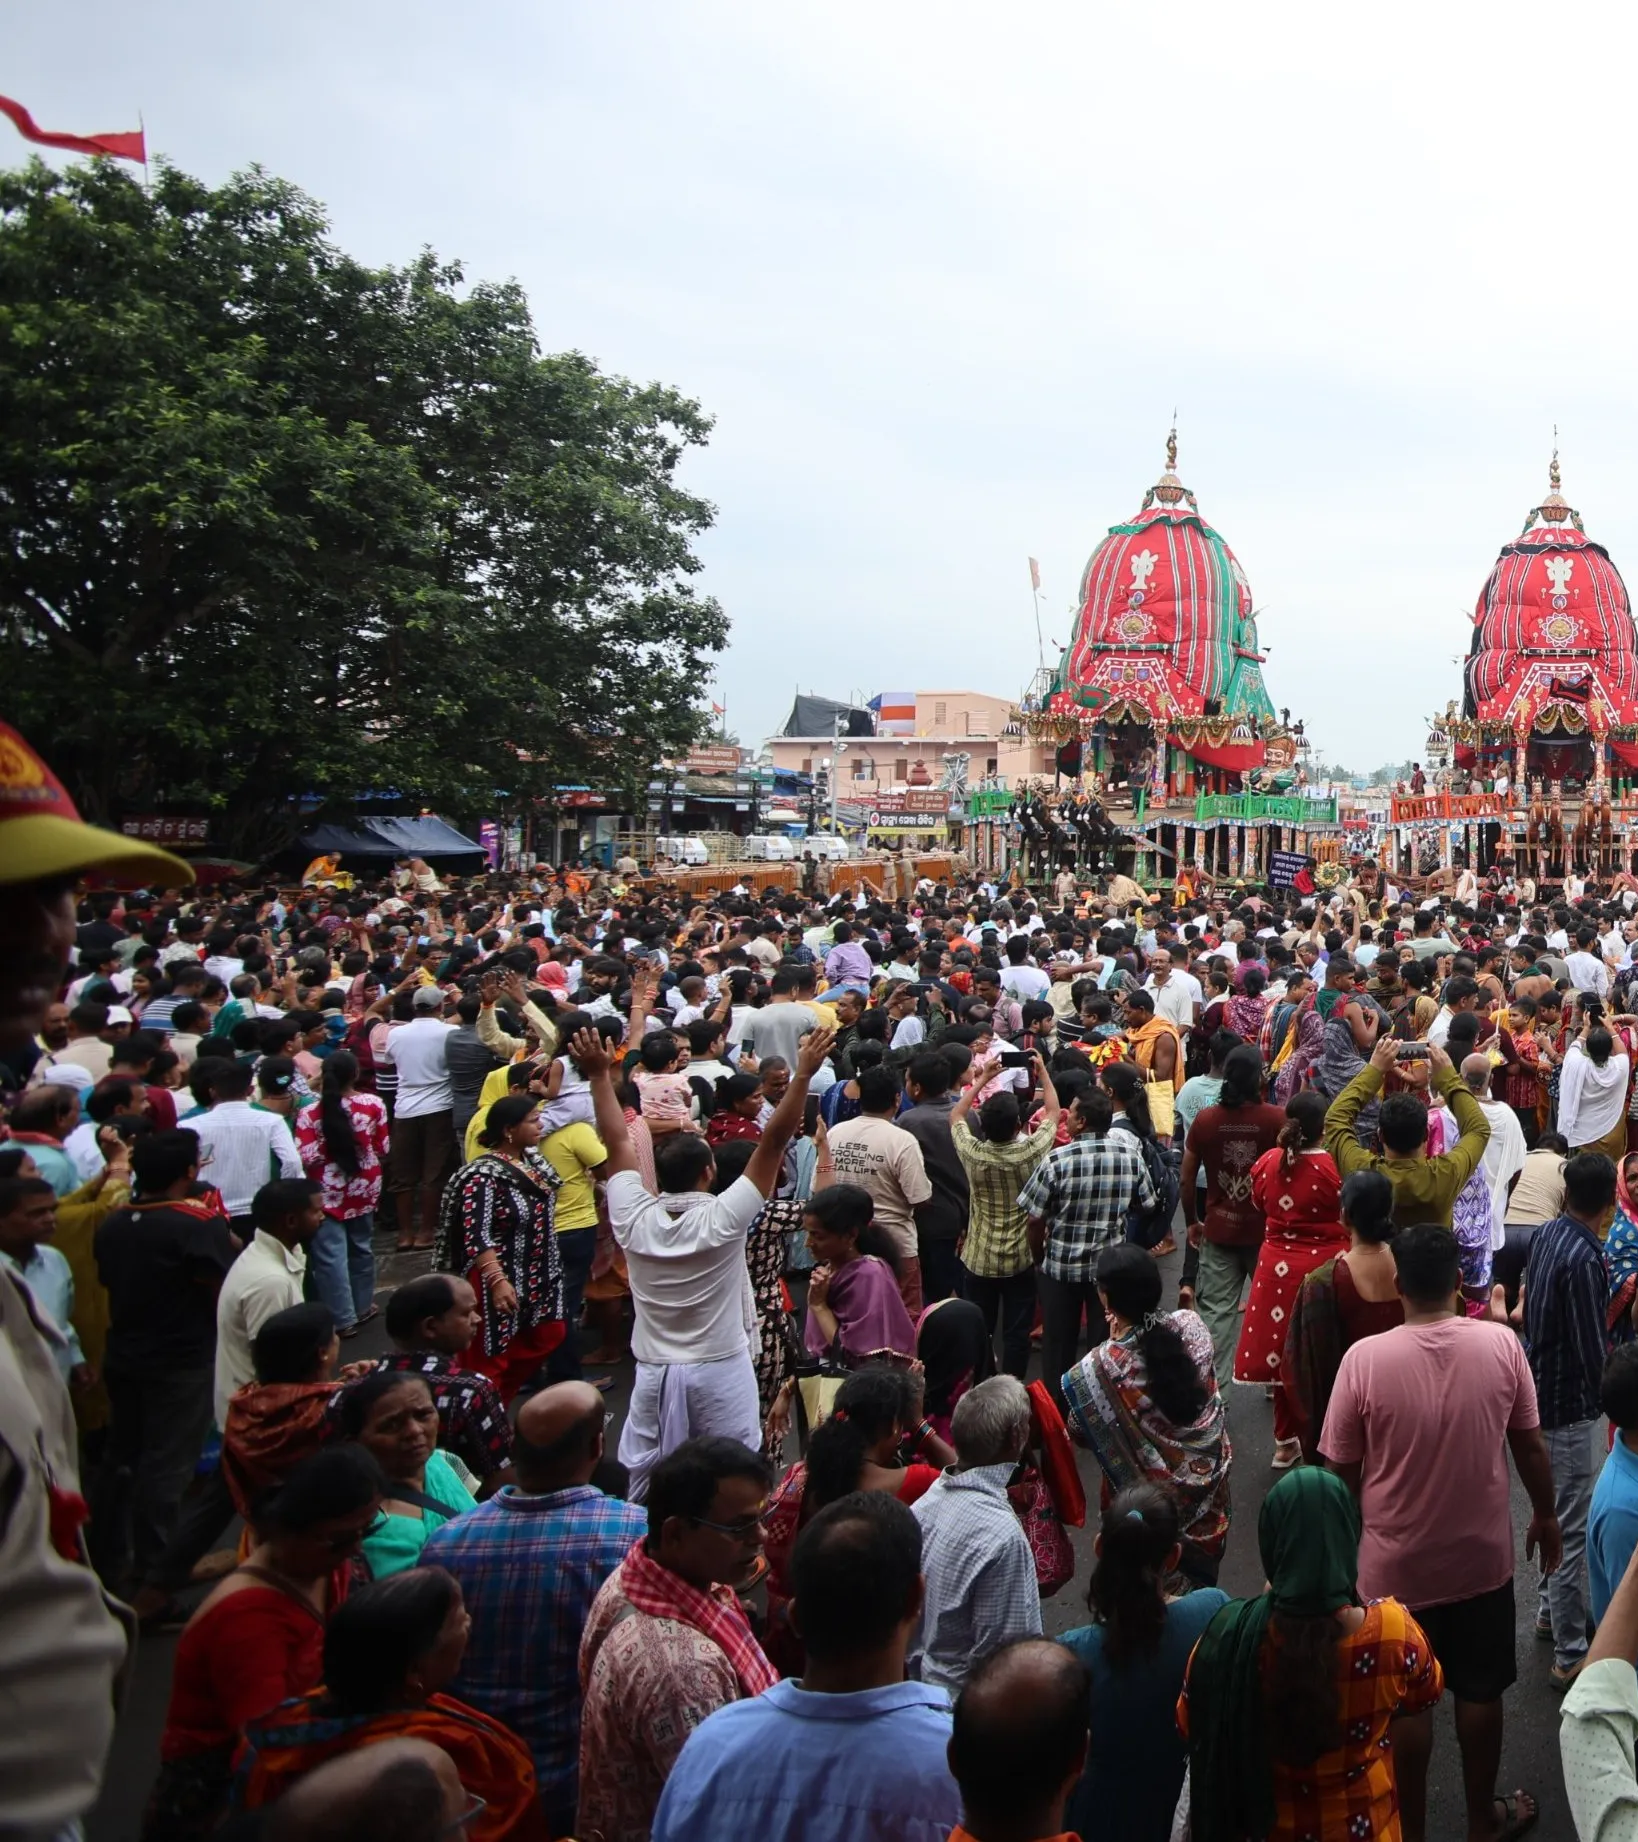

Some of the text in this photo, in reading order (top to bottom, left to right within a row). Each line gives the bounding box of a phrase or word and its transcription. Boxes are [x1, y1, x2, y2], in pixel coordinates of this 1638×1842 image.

[838, 1142, 868, 1151] LESS
[832, 1149, 884, 1162] ROLLING
[835, 1157, 866, 1167] MORE
[854, 1167, 878, 1175] LIFE
